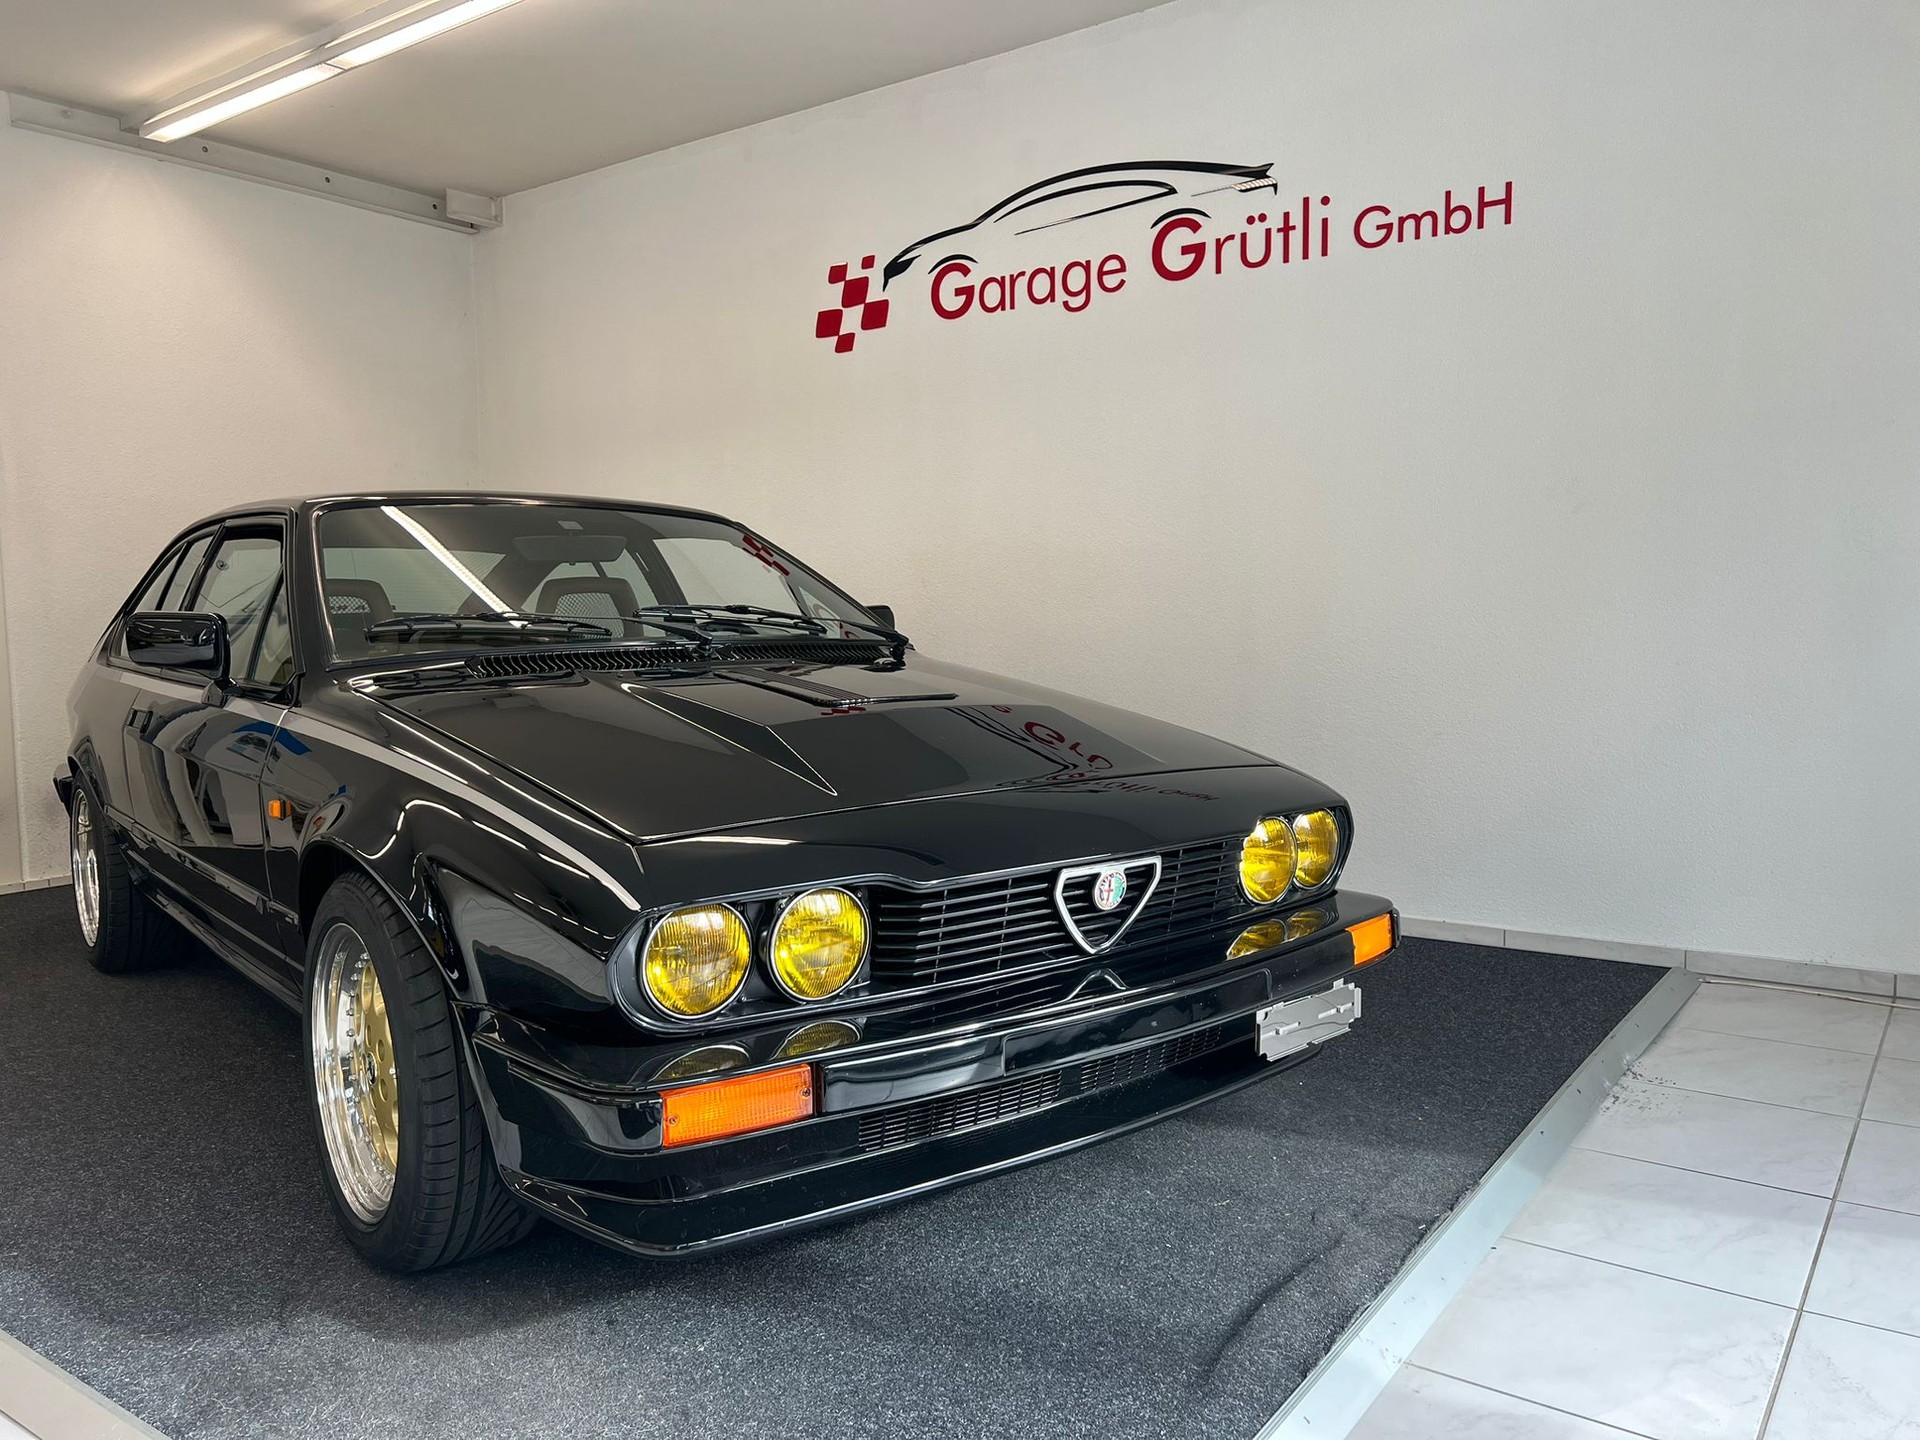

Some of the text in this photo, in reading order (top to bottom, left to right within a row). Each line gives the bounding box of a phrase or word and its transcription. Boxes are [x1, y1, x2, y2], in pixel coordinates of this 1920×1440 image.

[931, 181, 1513, 320] Garage Grütli GmbH
